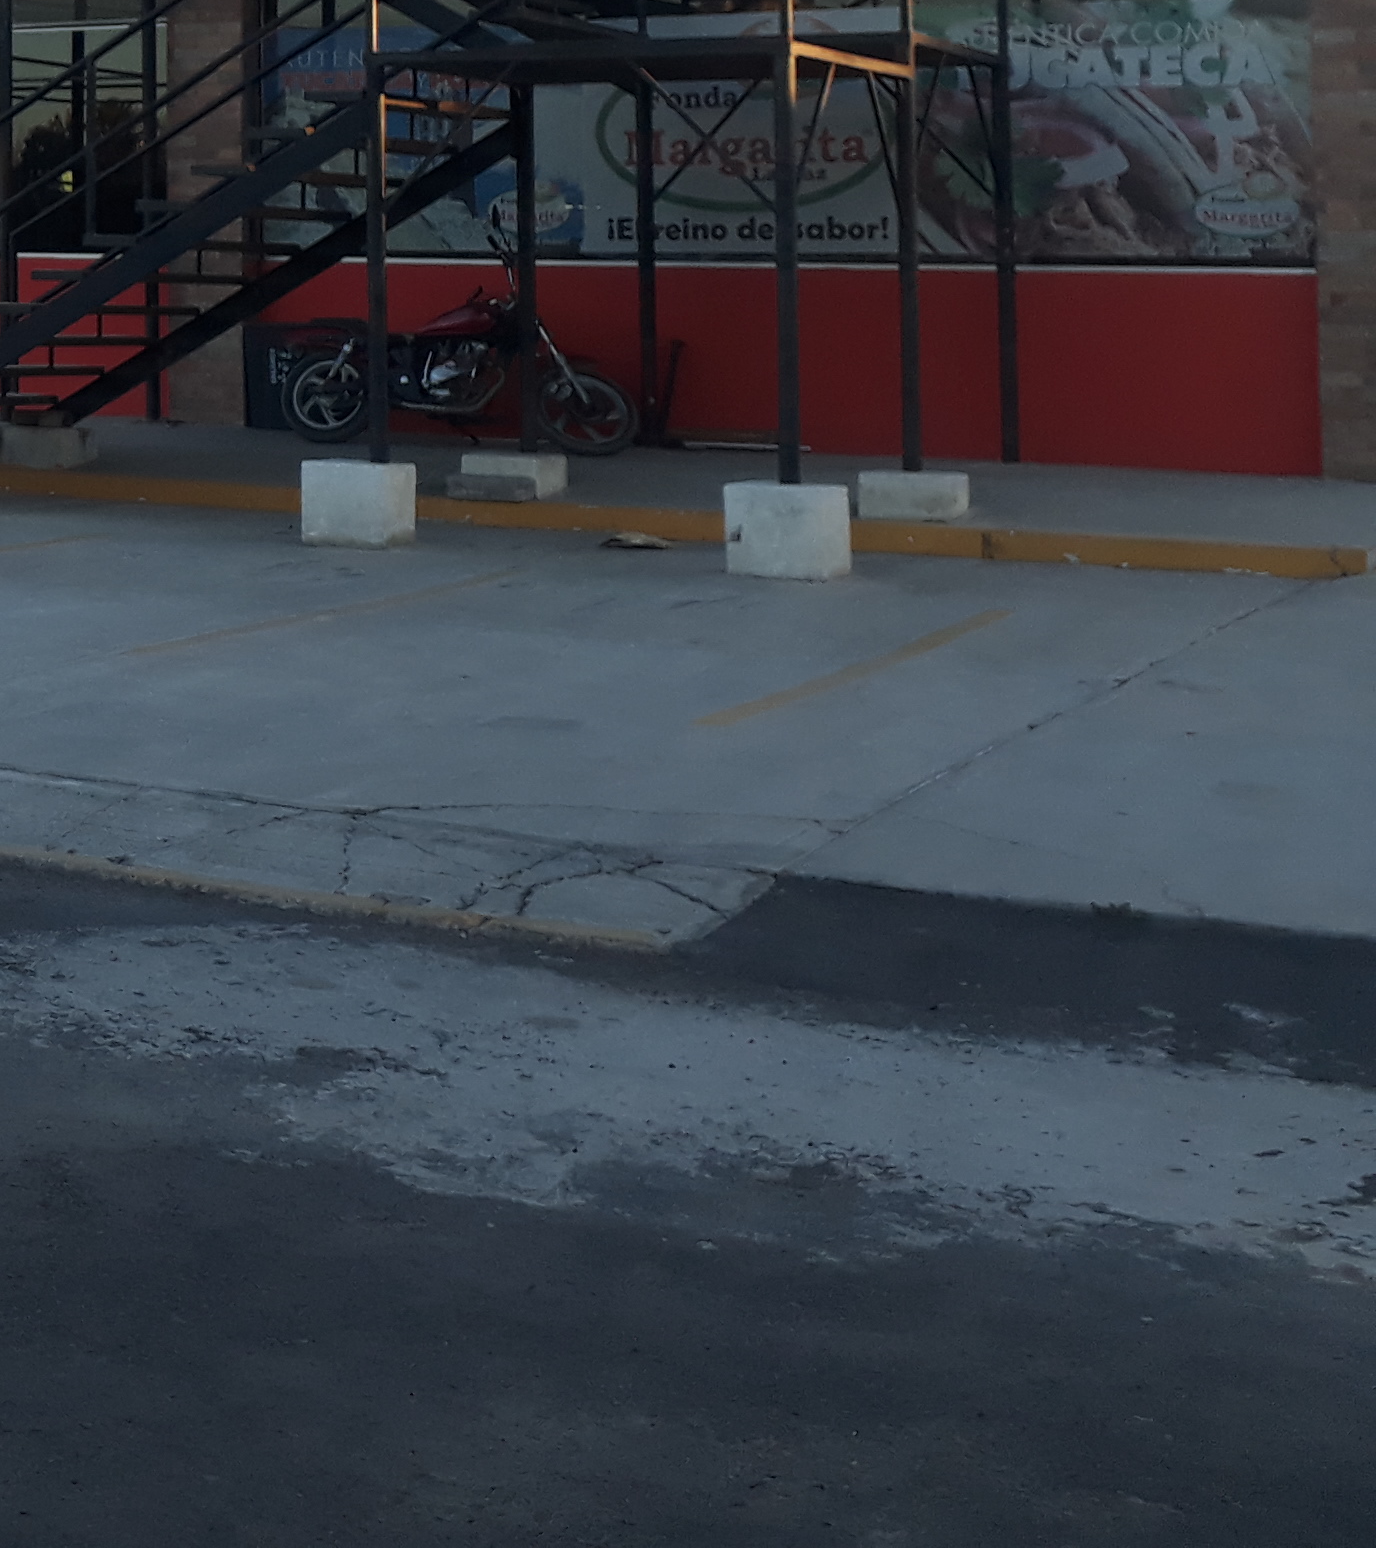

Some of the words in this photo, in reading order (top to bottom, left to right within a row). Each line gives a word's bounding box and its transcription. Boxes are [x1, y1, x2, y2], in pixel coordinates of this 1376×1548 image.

[650, 85, 740, 109] onda
[607, 218, 640, 241] ¡E
[737, 216, 776, 241] de
